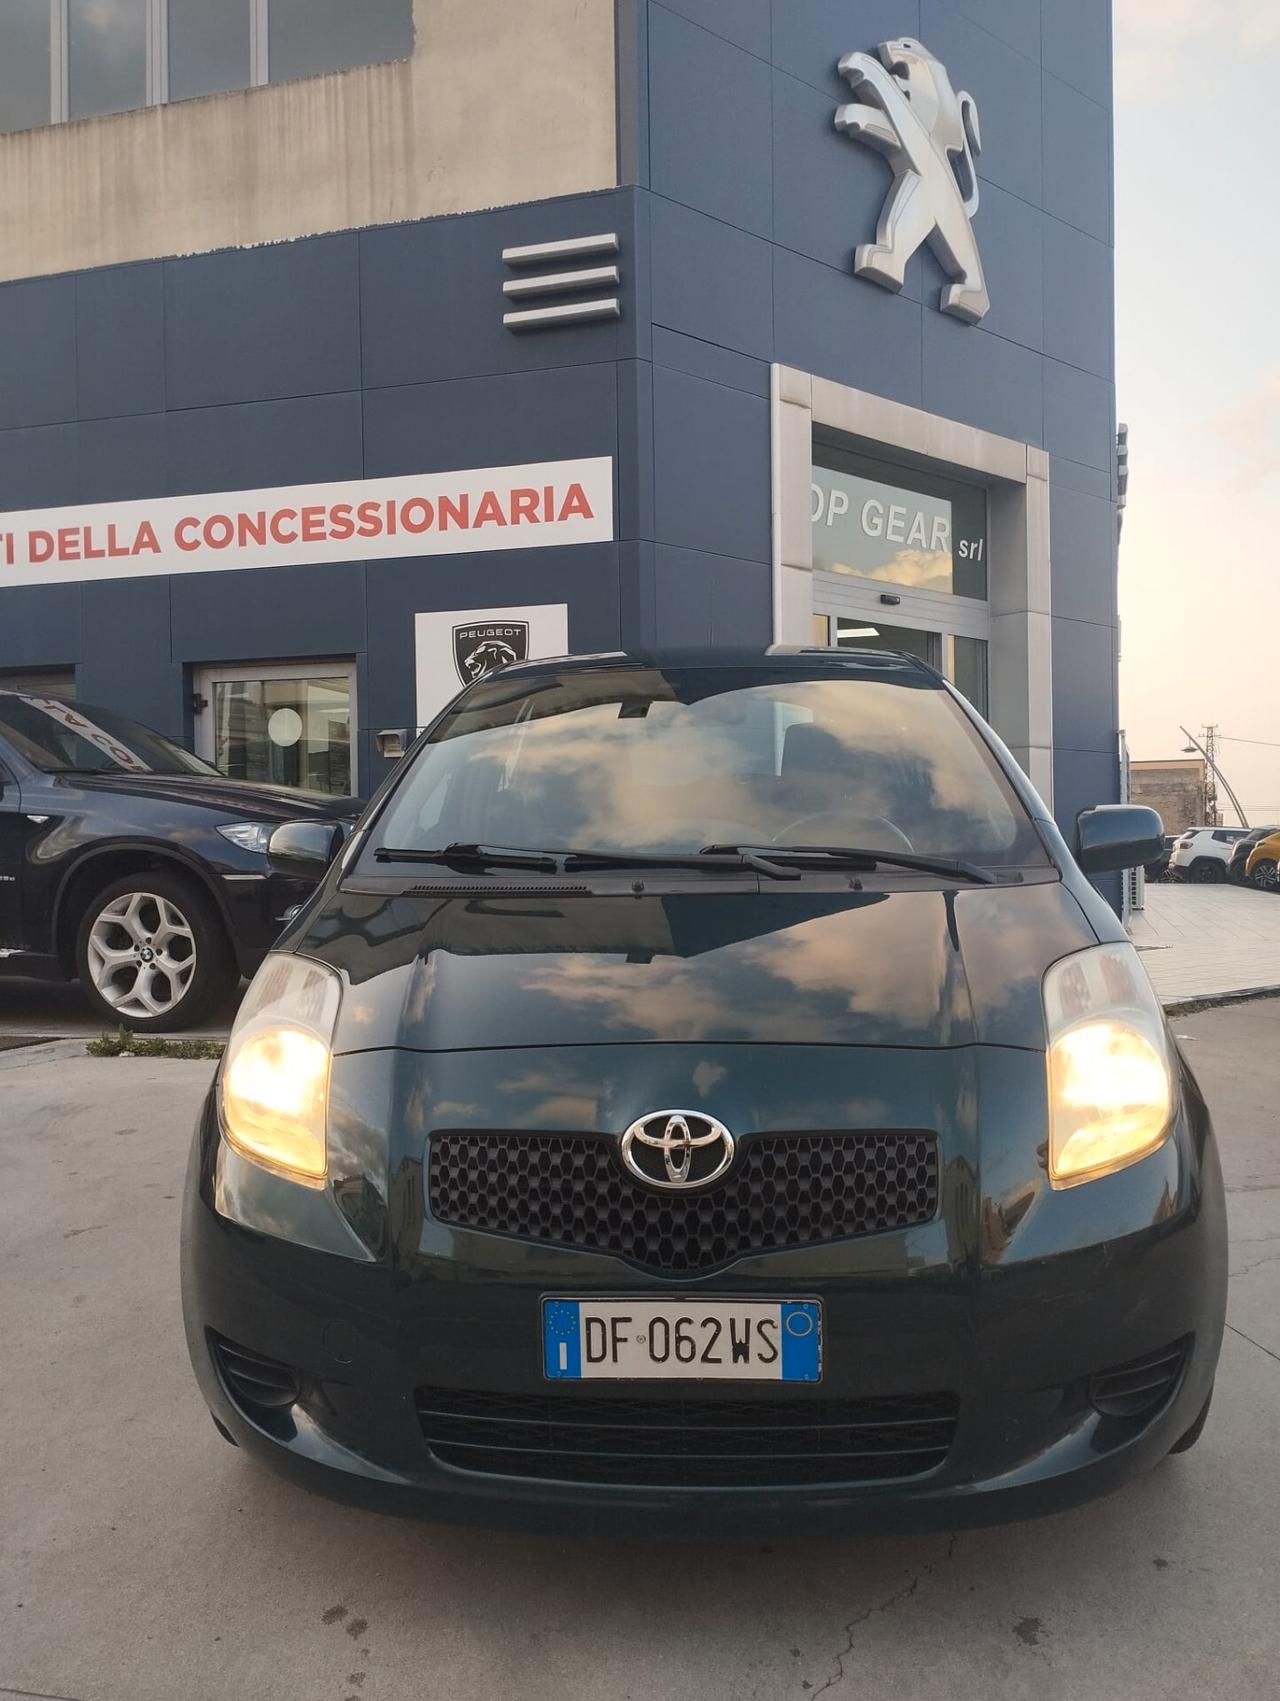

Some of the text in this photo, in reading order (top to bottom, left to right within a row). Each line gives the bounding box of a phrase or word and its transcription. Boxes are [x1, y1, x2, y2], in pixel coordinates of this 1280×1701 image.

[0, 482, 595, 565] I DELLA CONCESSIONARIA
[861, 498, 951, 553] GEAR
[957, 538, 984, 561] srl
[459, 628, 522, 640] PEUGEOT
[585, 1316, 633, 1363] DF
